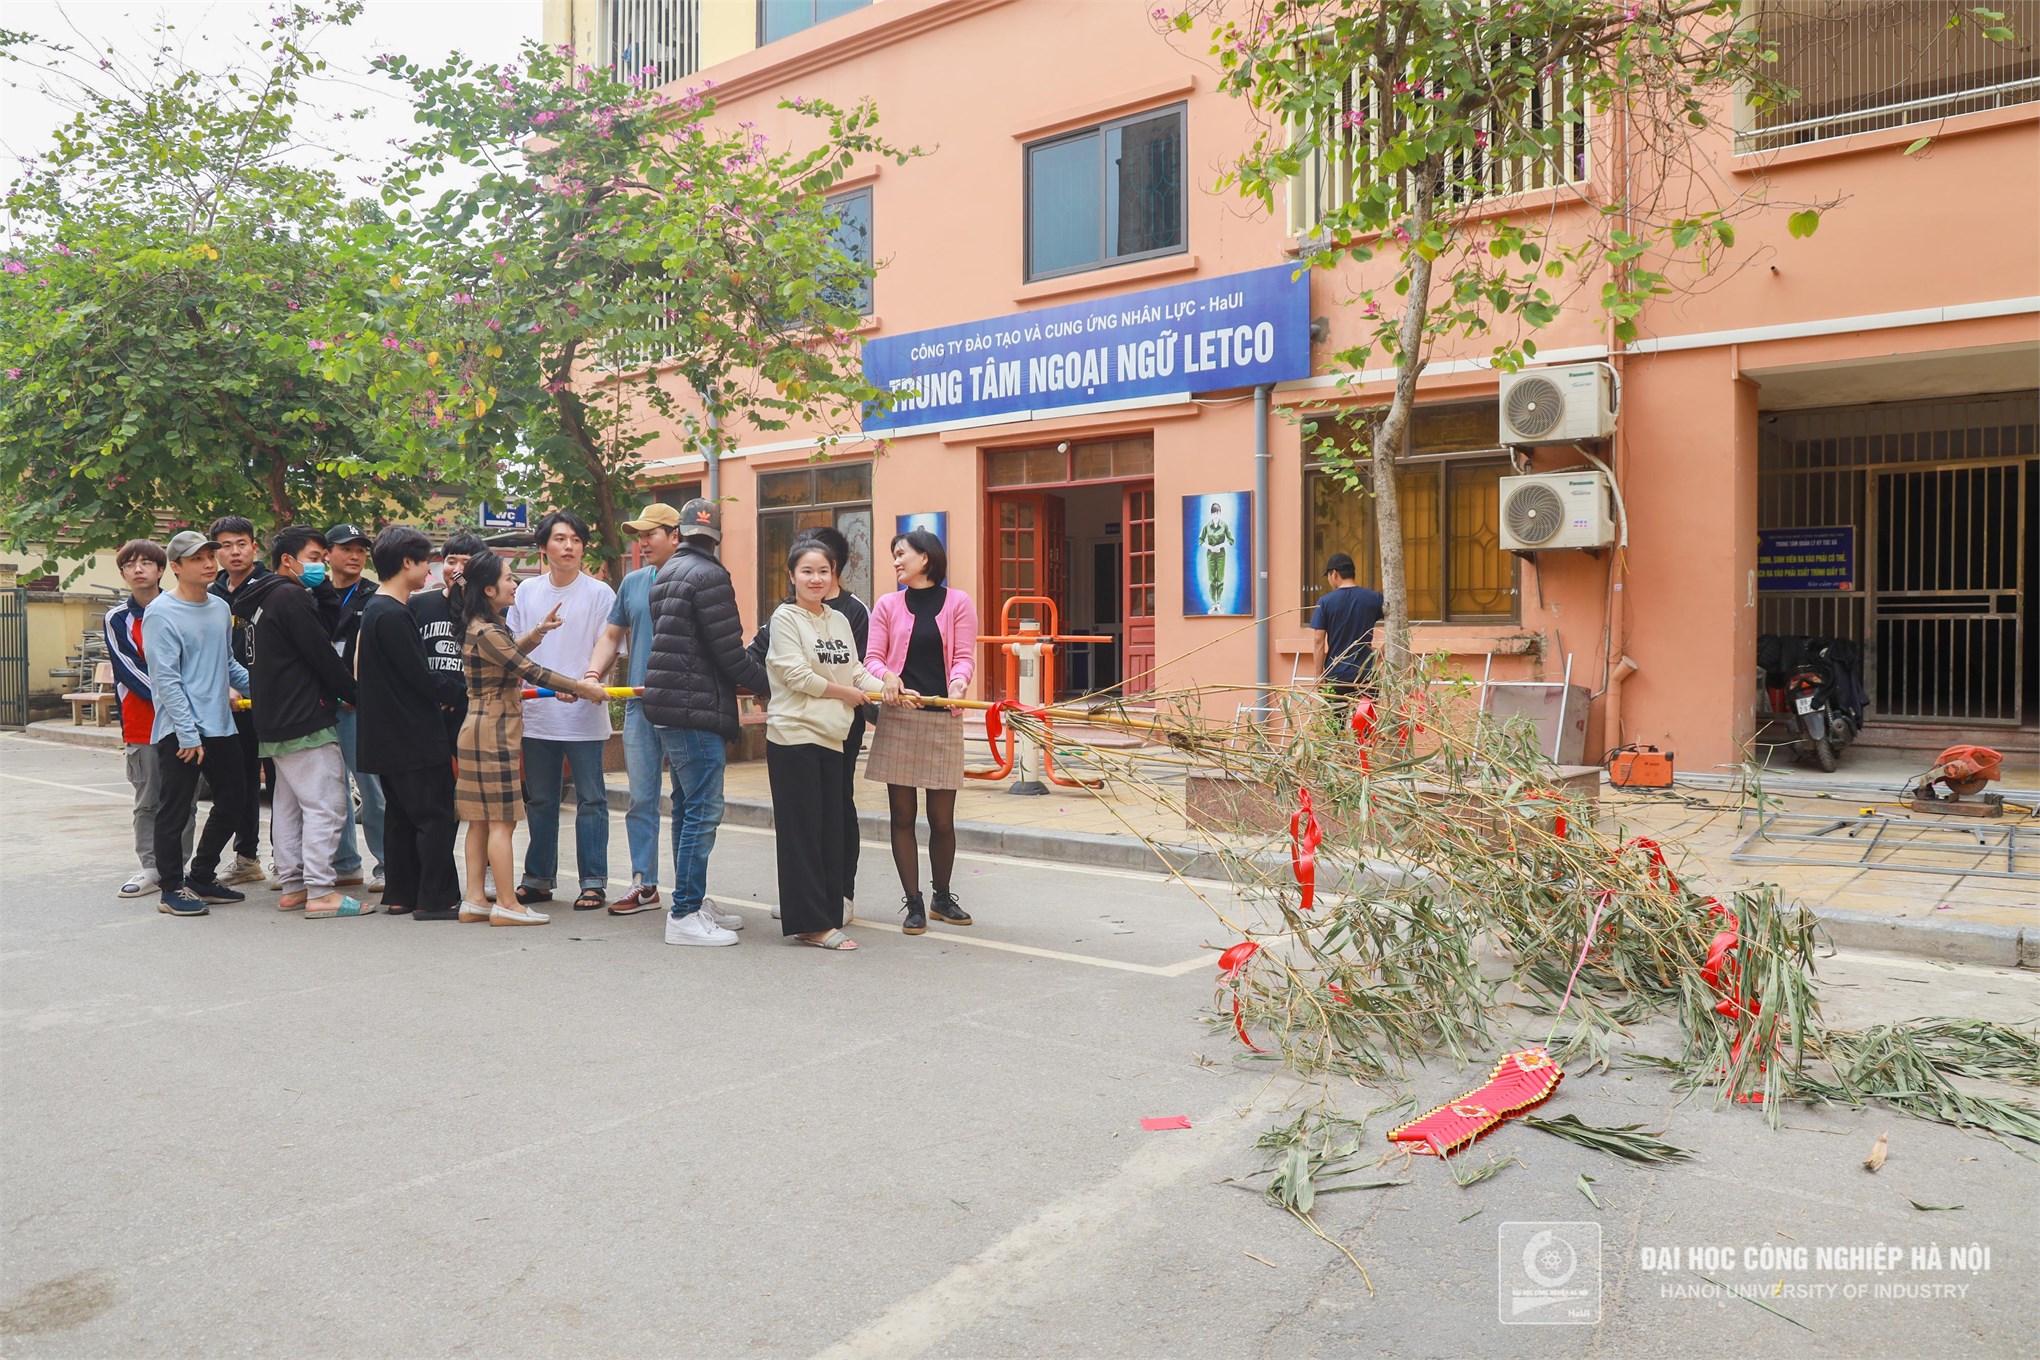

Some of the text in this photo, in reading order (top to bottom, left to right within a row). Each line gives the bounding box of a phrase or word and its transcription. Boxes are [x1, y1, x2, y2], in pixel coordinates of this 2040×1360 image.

[911, 343, 944, 360] CÔNG
[948, 340, 963, 355] TY
[965, 333, 992, 352] ĐÀO
[995, 330, 1021, 348] TẠO
[1024, 323, 1042, 342] VÀ
[1045, 319, 1083, 339] CUNG
[1087, 313, 1117, 332] ỨNG
[1121, 305, 1161, 327] NHÂN
[1165, 300, 1196, 321] LỰC
[1209, 291, 1243, 312] HaUI
[889, 321, 1274, 413] TRUNG TÂM NGOẠI NGỮ LETCO
[496, 511, 515, 520] WC
[817, 653, 850, 664] WARS
